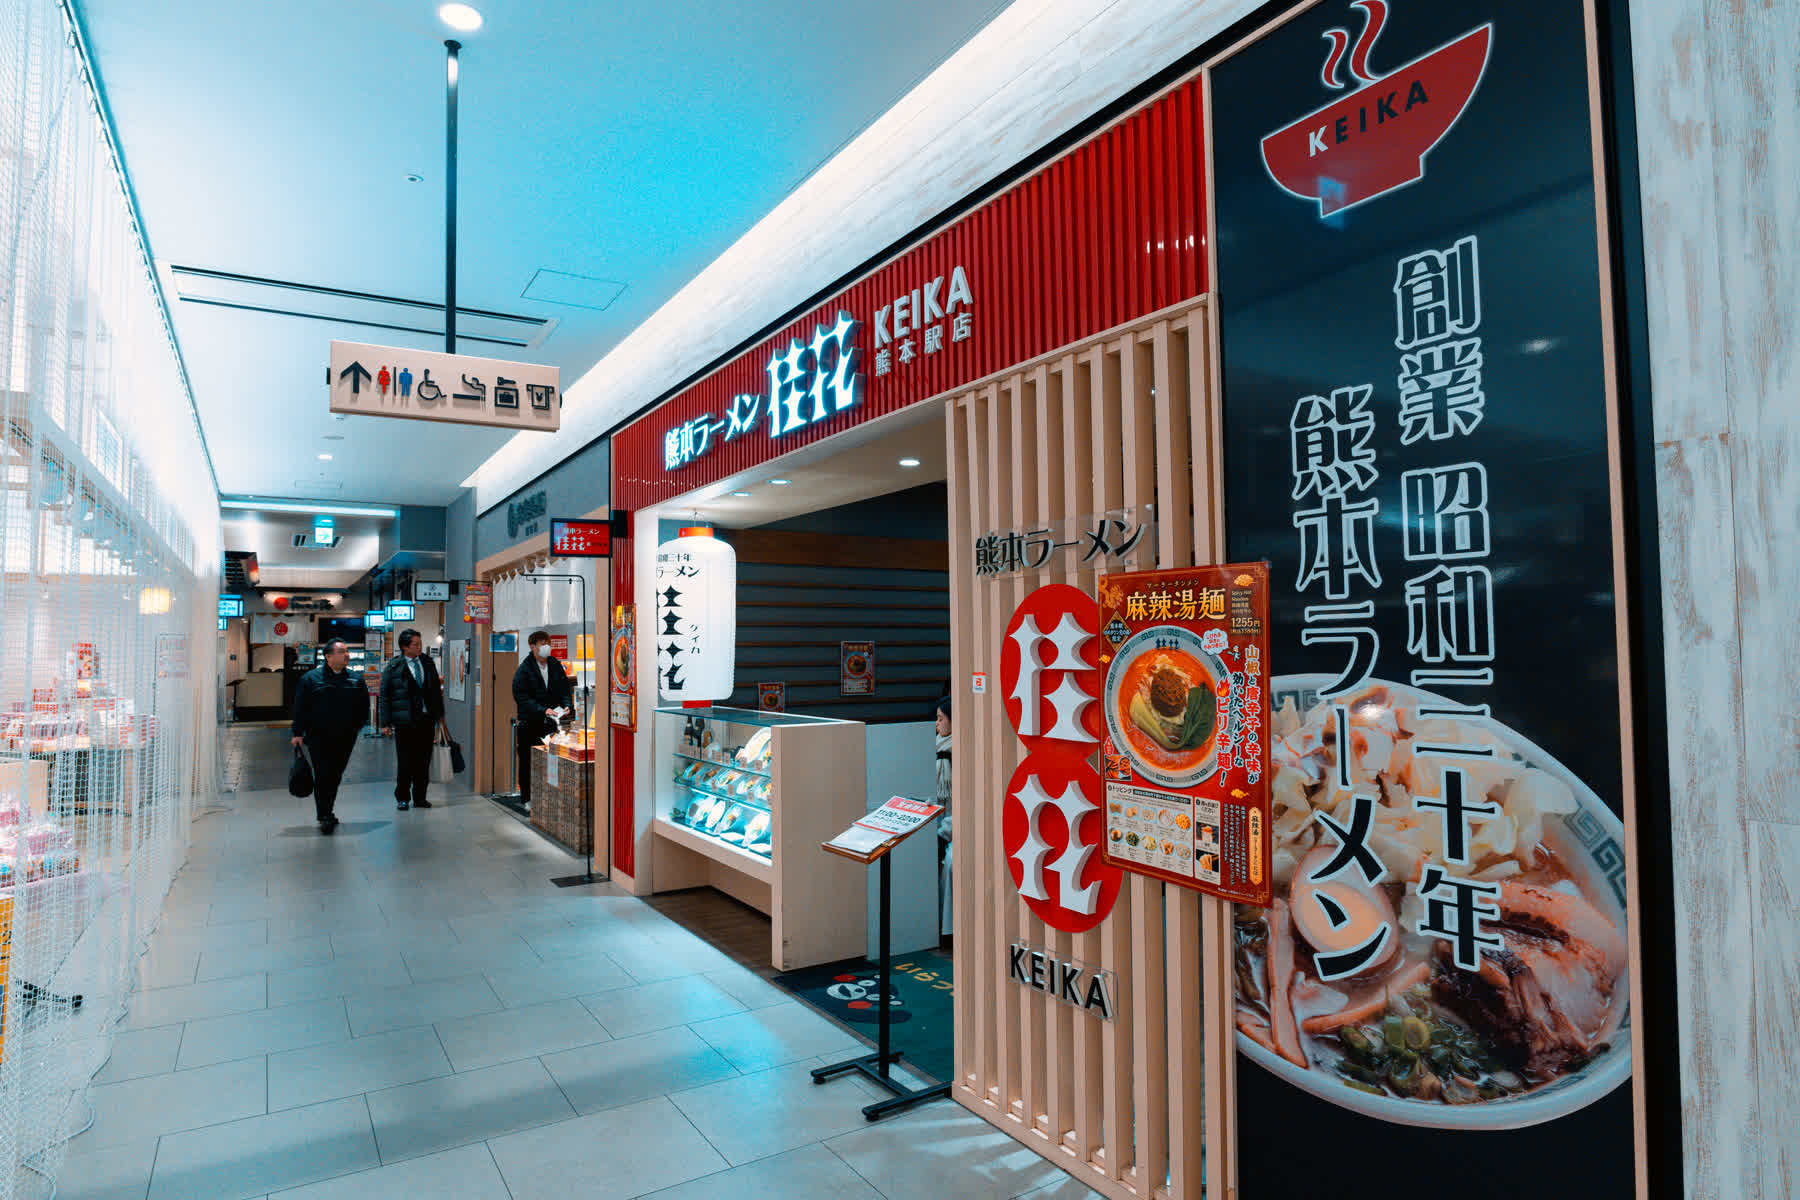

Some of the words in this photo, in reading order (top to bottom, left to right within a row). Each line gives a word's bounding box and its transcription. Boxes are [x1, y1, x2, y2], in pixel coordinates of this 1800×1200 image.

[1308, 79, 1429, 158] KEIKA
[874, 265, 973, 349] KEIKA
[875, 312, 972, 377] 熊本駅店
[766, 309, 856, 438] 桂花
[664, 394, 761, 471] 熊本ラーメン
[975, 519, 1146, 577] 熊本ラーメン
[1125, 587, 1227, 621] 麻辣湯麺
[1290, 383, 1393, 983] 熊本ラーメン
[1008, 612, 1102, 916] 桂花
[1011, 944, 1113, 1018] KEIKA
